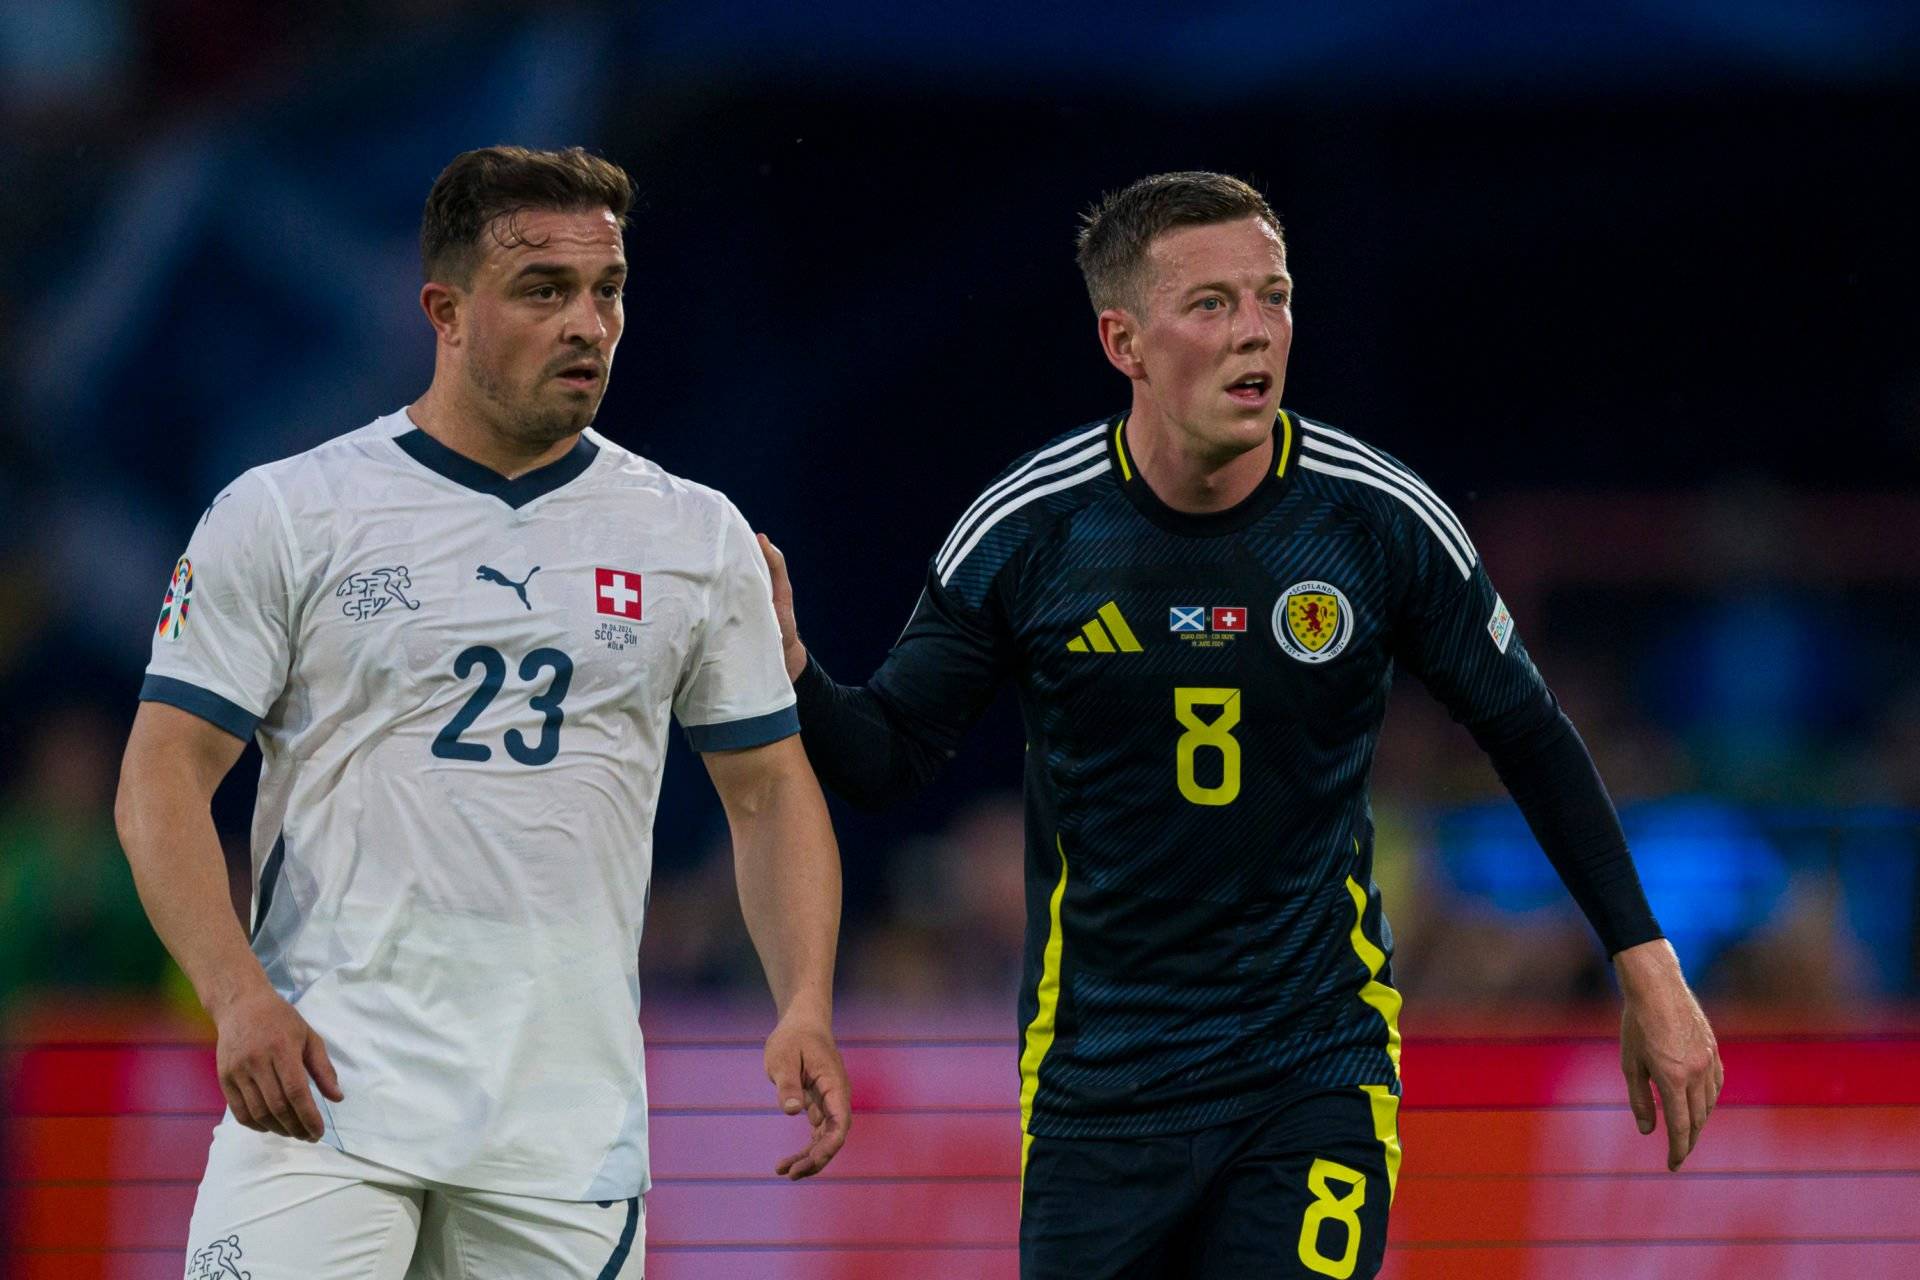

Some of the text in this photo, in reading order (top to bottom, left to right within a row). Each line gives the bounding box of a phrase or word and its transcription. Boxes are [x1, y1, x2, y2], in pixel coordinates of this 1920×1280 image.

[1292, 583, 1333, 594] SCOTLAND
[594, 630, 613, 641] SCO
[624, 633, 638, 645] SUI
[607, 640, 624, 651] KÖLN
[1330, 644, 1343, 657] 1873
[432, 645, 574, 766] 23
[1174, 687, 1241, 806] 8
[1298, 1158, 1366, 1279] 8
